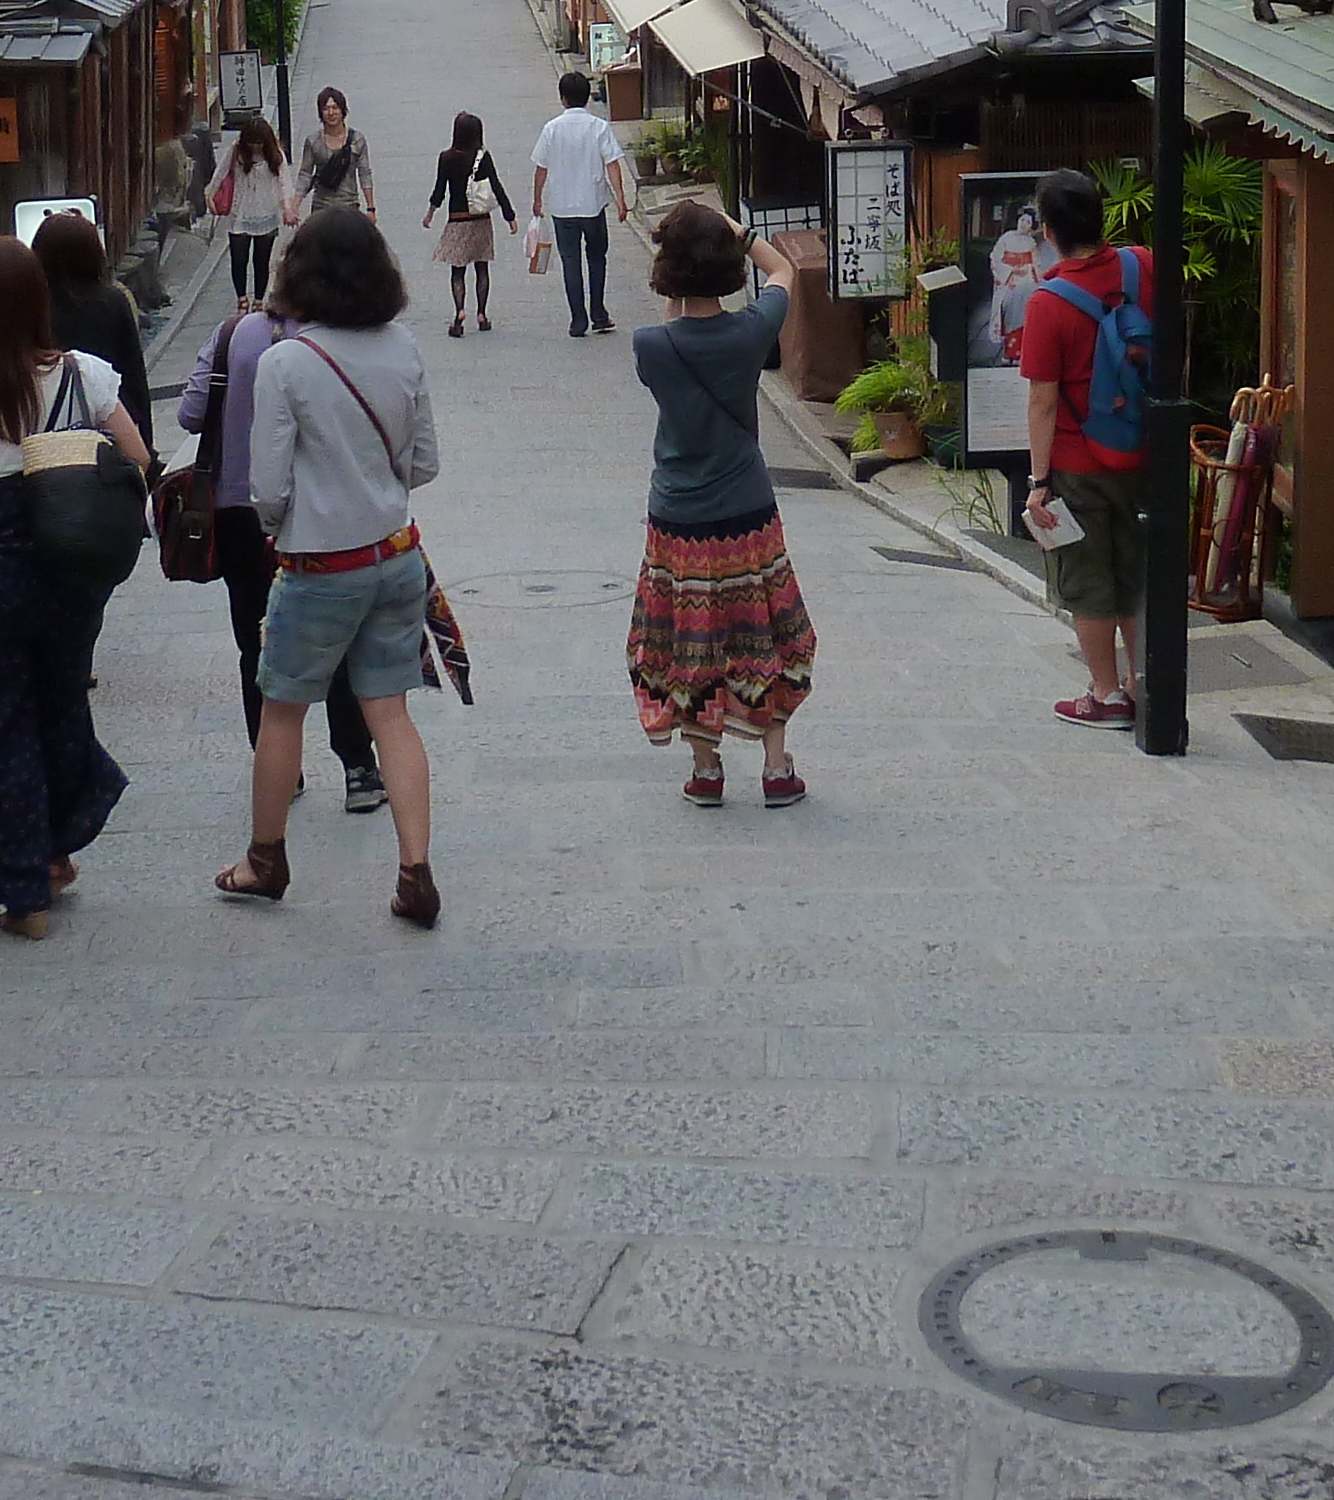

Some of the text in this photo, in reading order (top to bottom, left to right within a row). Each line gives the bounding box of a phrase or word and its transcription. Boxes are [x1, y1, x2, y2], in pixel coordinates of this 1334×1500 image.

[885, 162, 902, 217] そば処
[840, 225, 865, 284] ふたば
